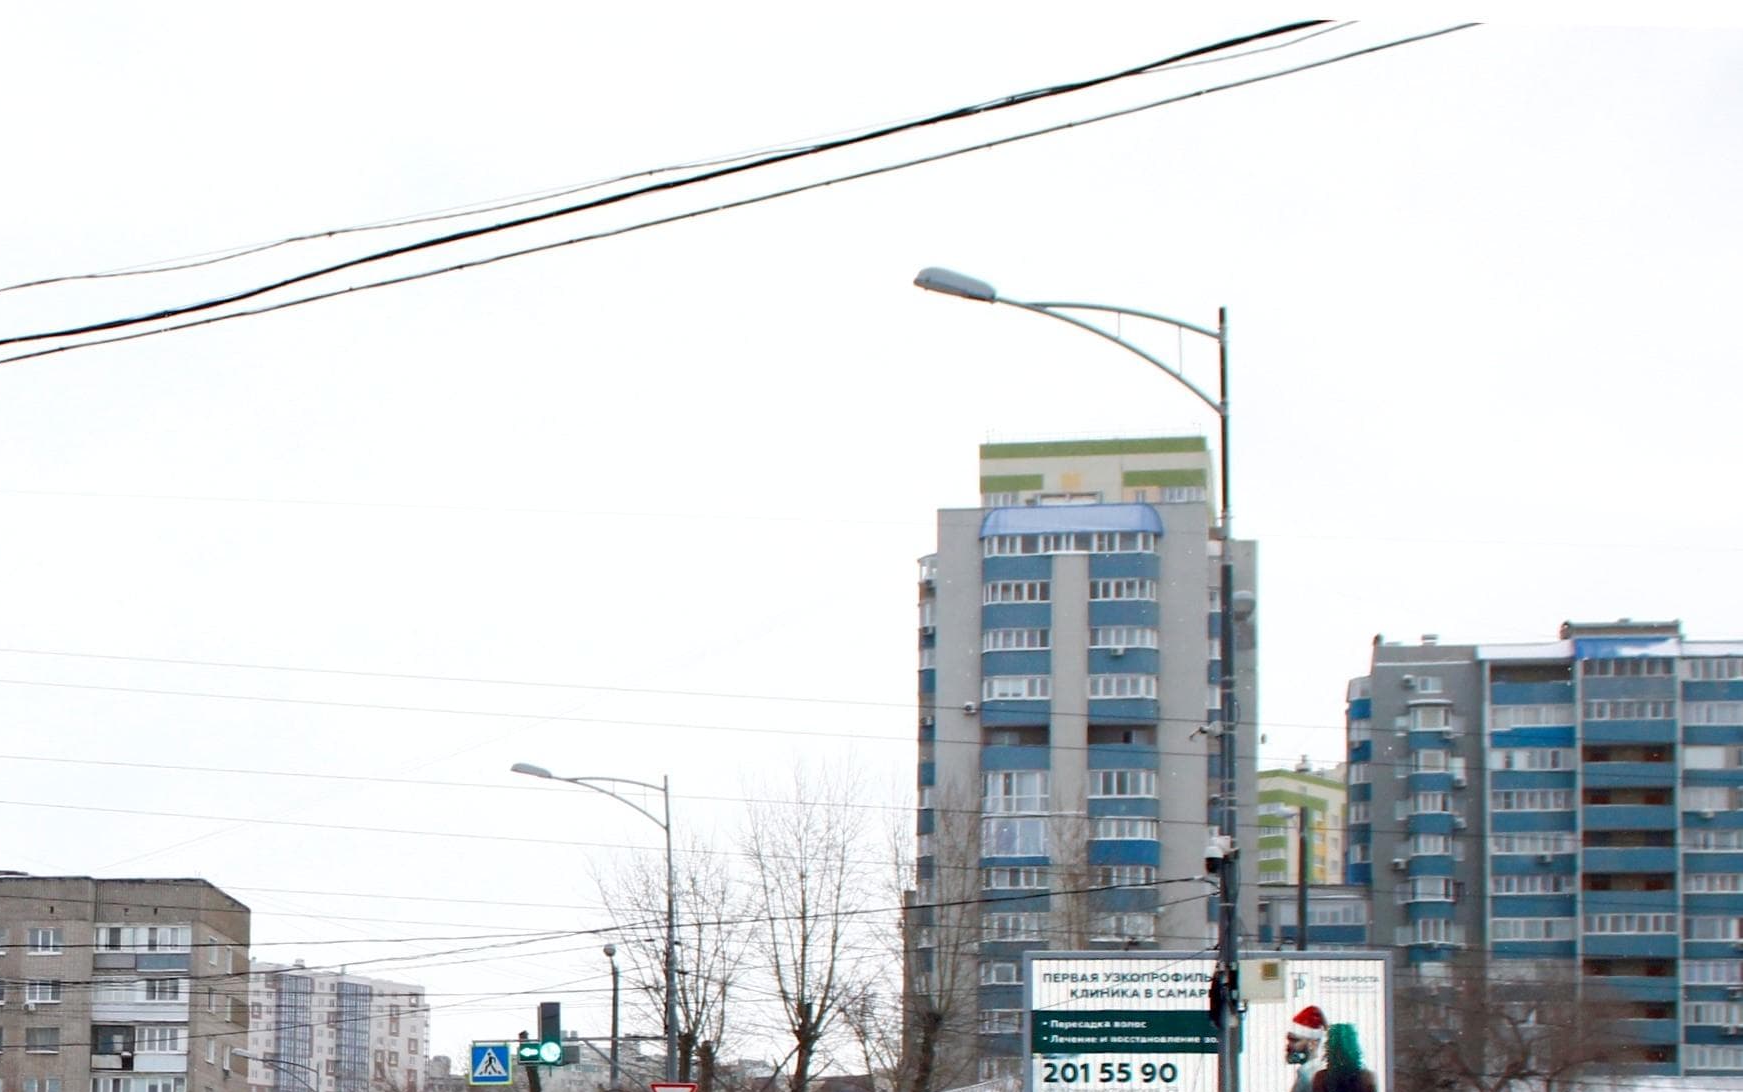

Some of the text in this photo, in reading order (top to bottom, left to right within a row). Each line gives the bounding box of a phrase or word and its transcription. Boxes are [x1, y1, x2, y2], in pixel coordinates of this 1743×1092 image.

[1042, 972, 1214, 983] ПЕРВАЯ УЗКОПРОФИЛЬ
[1070, 988, 1211, 999] КЛИНИКА В САМАР
[1050, 1019, 1147, 1029] Пересадка волос
[1049, 1035, 1098, 1044] Лечение
[1110, 1036, 1201, 1044] восстановление
[1043, 1062, 1177, 1083] 201 55 90
